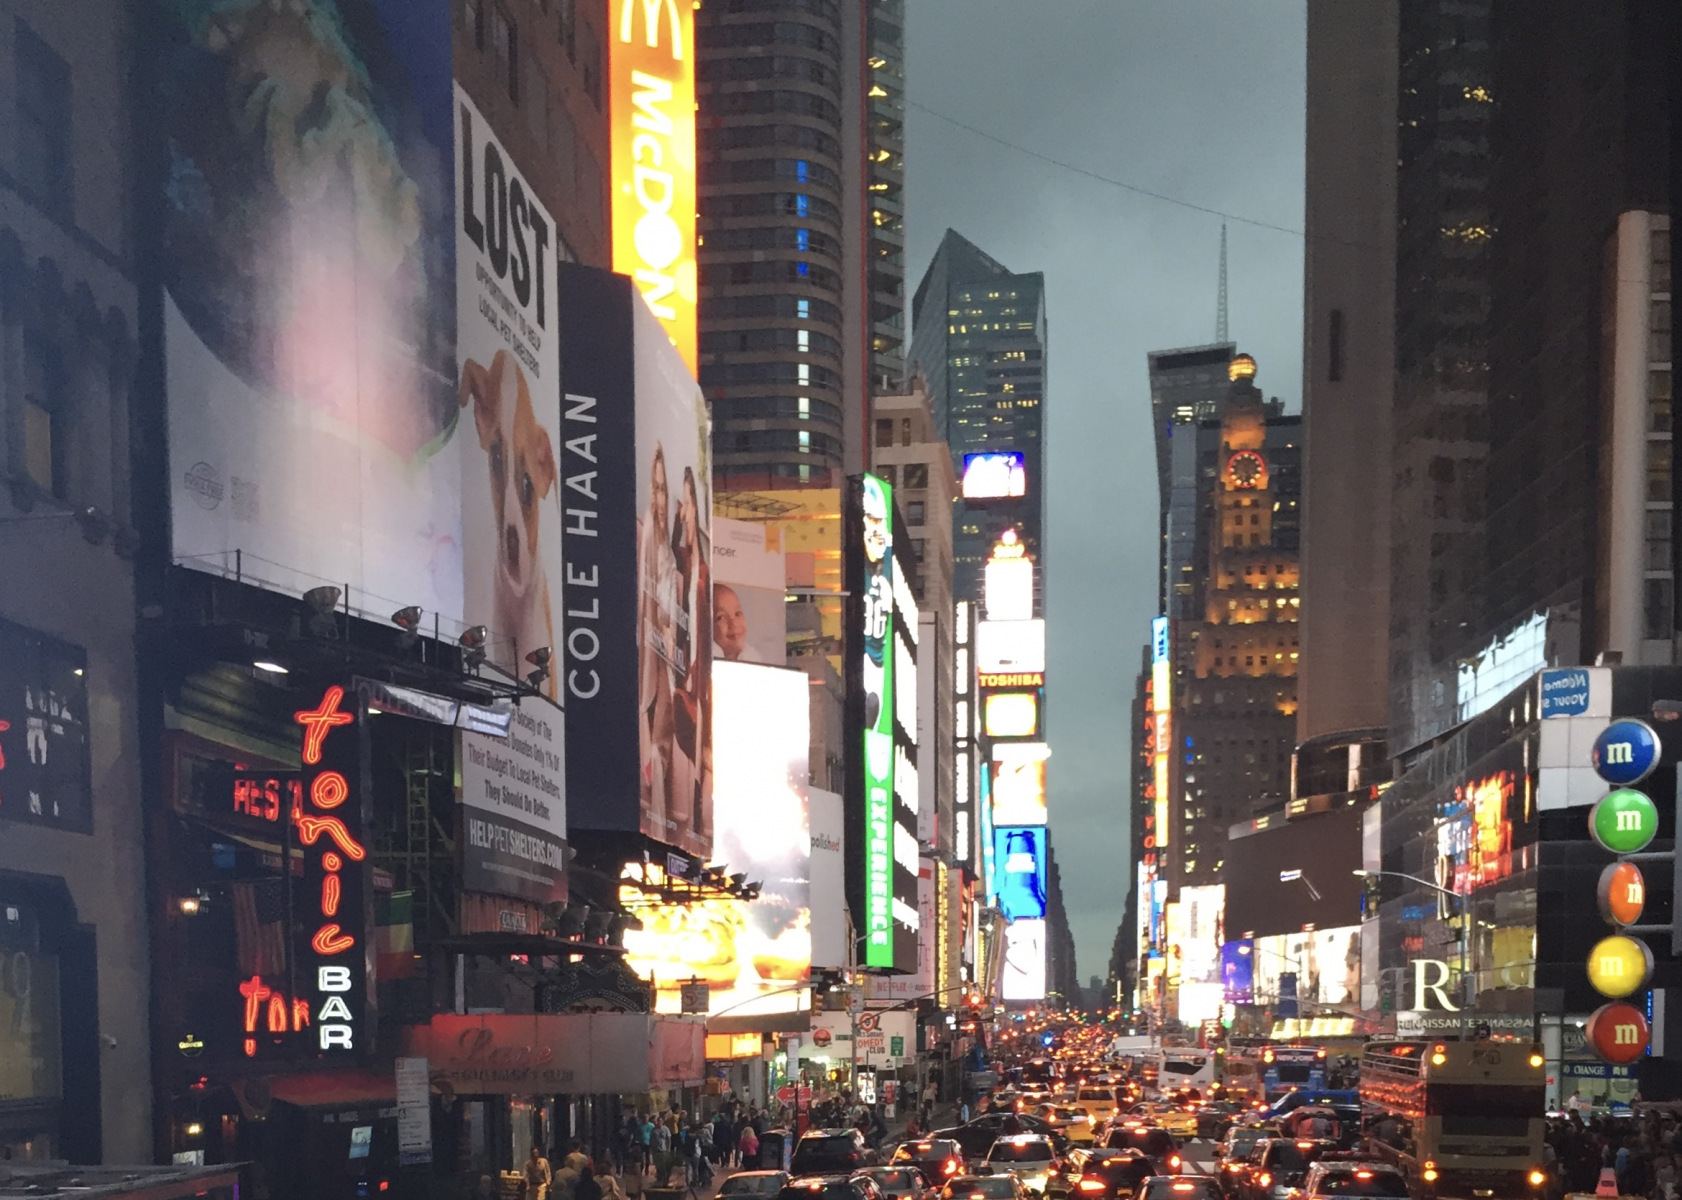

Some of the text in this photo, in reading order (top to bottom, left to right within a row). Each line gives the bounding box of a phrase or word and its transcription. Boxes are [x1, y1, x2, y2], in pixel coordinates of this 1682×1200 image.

[460, 101, 548, 332] LOST
[564, 393, 600, 699] COLE HAAN
[979, 673, 1043, 686] TOSHIBA
[517, 706, 536, 736] Society
[467, 742, 486, 768] Their
[486, 750, 509, 778] Budget
[517, 763, 532, 786] Local
[532, 770, 540, 790] Pet
[1606, 742, 1633, 764] m
[485, 779, 500, 806] They
[502, 785, 523, 810] Should
[524, 794, 532, 814] Do
[295, 686, 365, 955] tonic
[1616, 810, 1642, 831] m
[870, 786, 888, 946] EXPERIENCE
[1600, 956, 1623, 976] m
[877, 982, 907, 992] NETFLIX
[1410, 959, 1461, 1012] R
[318, 966, 353, 1050] BAR
[857, 1038, 884, 1048] OMEDY
[1614, 1024, 1638, 1045] m
[869, 1046, 885, 1054] CLUB
[1573, 1065, 1606, 1076] CHANGE
